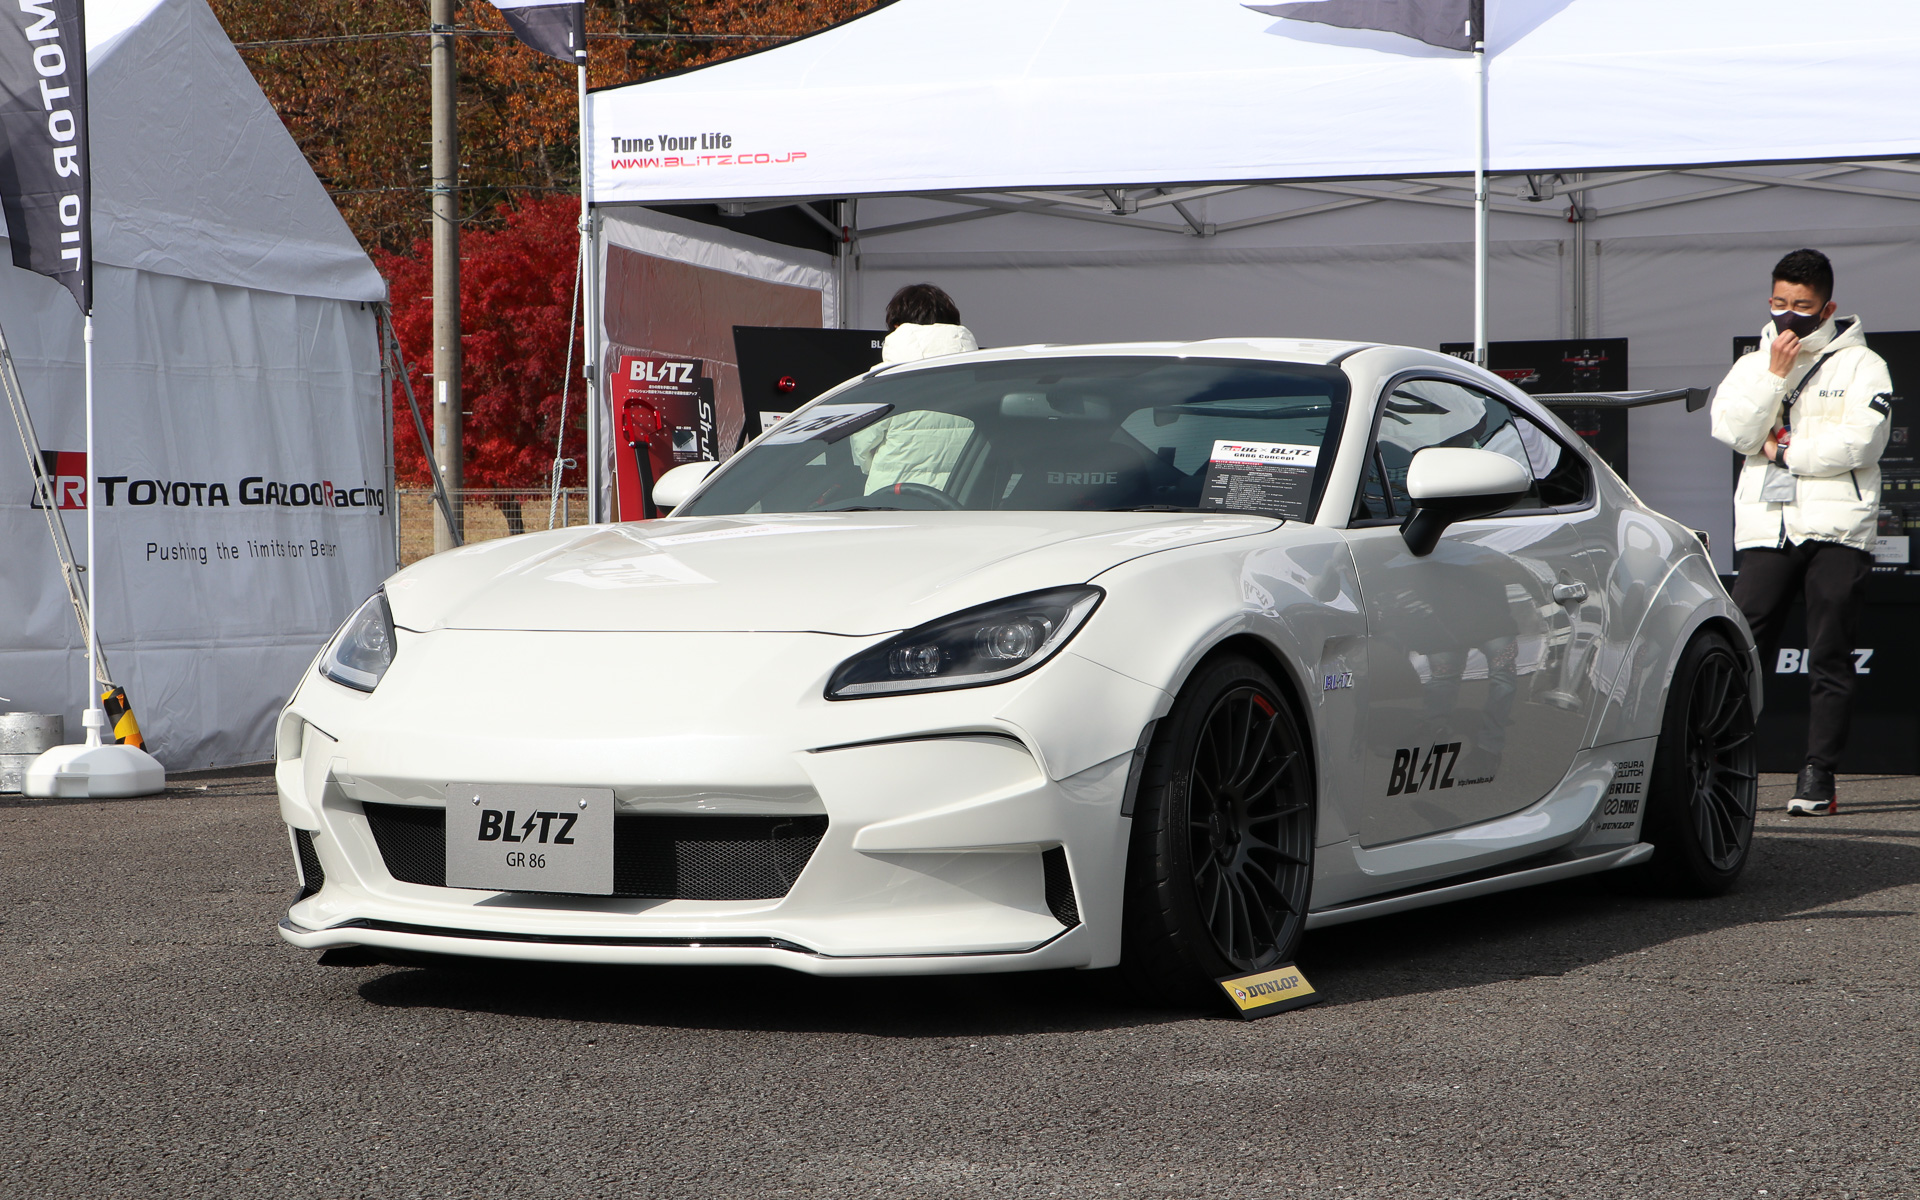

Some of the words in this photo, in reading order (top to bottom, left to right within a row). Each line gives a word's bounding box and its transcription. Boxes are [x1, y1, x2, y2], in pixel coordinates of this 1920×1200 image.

[611, 137, 654, 153] Tune
[658, 134, 698, 152] Your
[701, 132, 733, 150] Life
[629, 359, 695, 384] BLITZ
[1818, 389, 1846, 398] BLITZ
[698, 398, 716, 462] Strut
[1269, 447, 1313, 457] BLITZ
[1046, 471, 1119, 485] BRIDE
[97, 475, 231, 507] TOYOTA
[146, 541, 208, 565] Pushing
[217, 541, 240, 560] the
[246, 539, 286, 559] limits
[287, 540, 305, 558] for
[1775, 647, 1875, 674] BLZ
[1323, 671, 1353, 691] BLITZ
[1386, 741, 1462, 797] BLITZ
[1617, 769, 1644, 778] CLUTCH
[1618, 760, 1645, 770] OGURA
[1608, 782, 1642, 795] BRIDE
[1618, 799, 1640, 814] ENKEI
[477, 808, 579, 845] BLITZ
[1600, 821, 1635, 831] DUNLOP
[506, 851, 526, 868] GR
[528, 852, 546, 869] 86
[1245, 975, 1300, 998] DUNLOP
